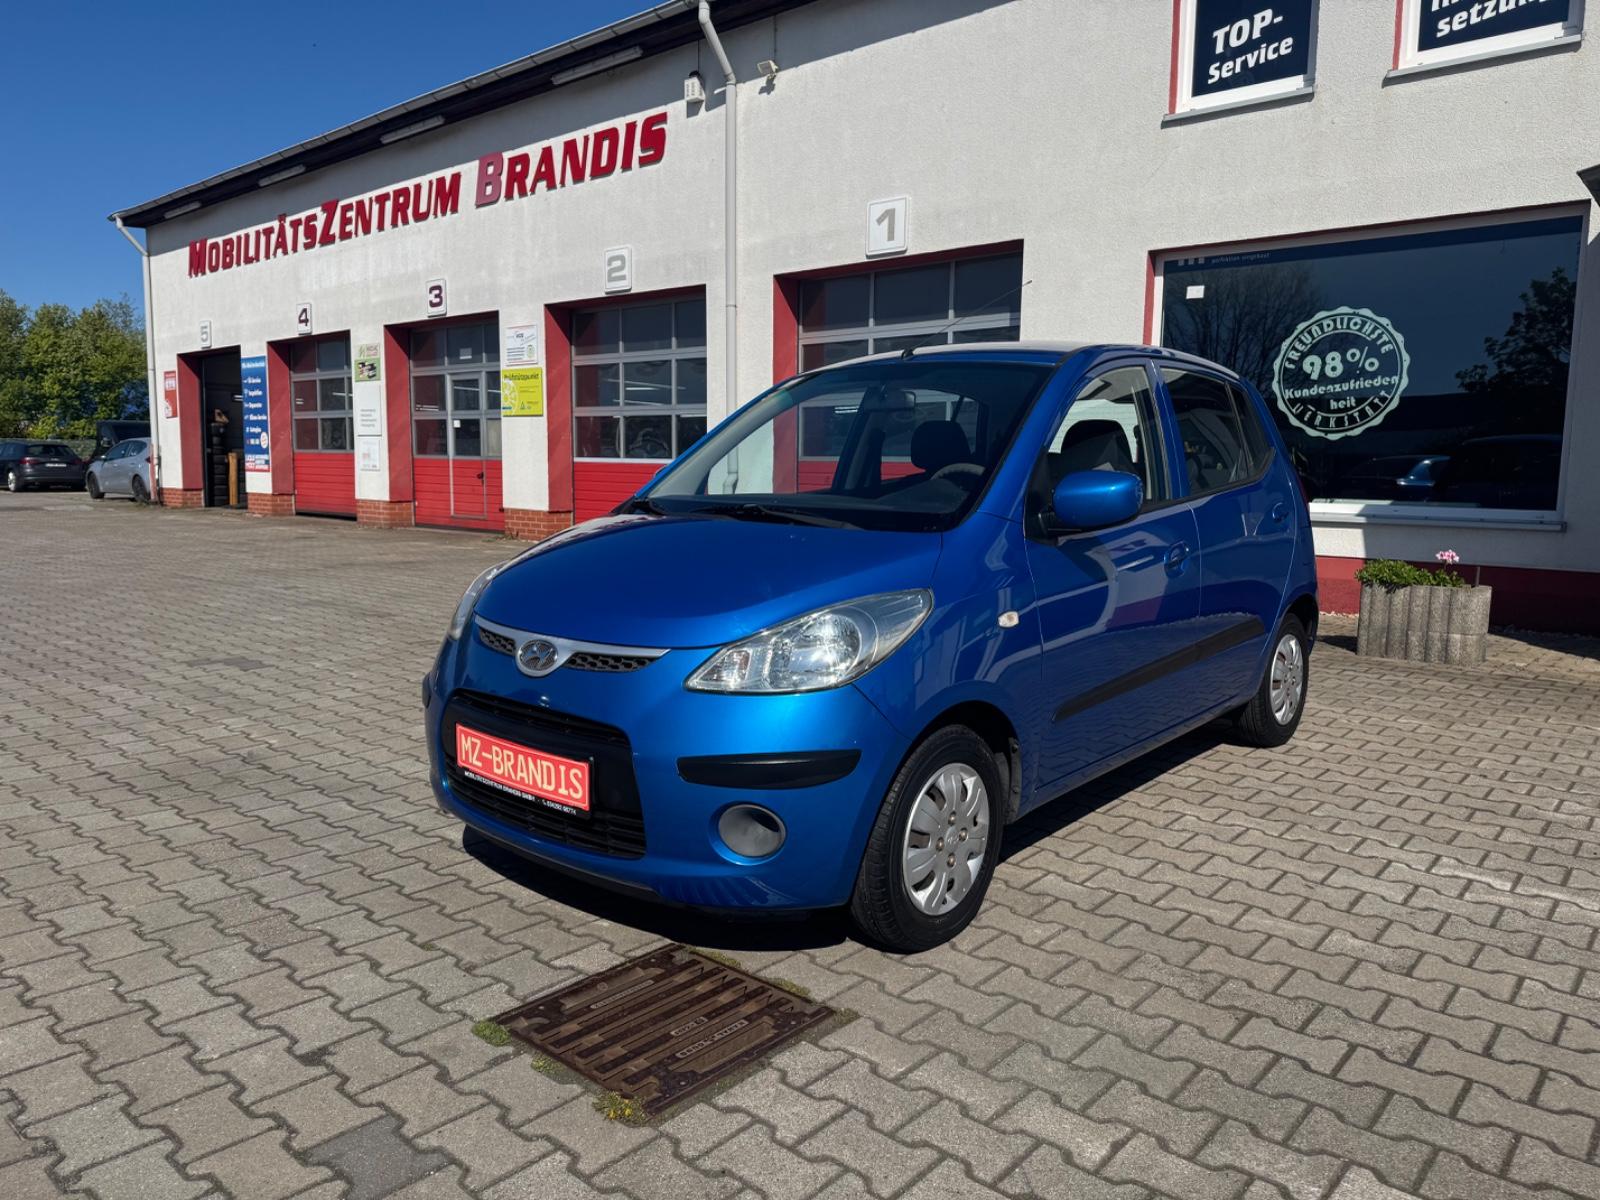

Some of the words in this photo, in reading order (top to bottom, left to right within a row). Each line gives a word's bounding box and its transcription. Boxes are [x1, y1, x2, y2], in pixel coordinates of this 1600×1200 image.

[1213, 8, 1283, 55] TOP-
[1207, 37, 1293, 84] Service
[475, 111, 667, 208] BRANDIS
[876, 207, 896, 242] 1
[607, 254, 627, 283] 2
[429, 285, 444, 308] 3
[298, 308, 310, 327] 4
[200, 325, 209, 343] 5
[1284, 315, 1394, 370] FREUNDLICHSTE
[1285, 375, 1399, 399] Kundenzufrieden
[1330, 396, 1356, 410] heit
[461, 733, 583, 799] MZ-BRANDIS
